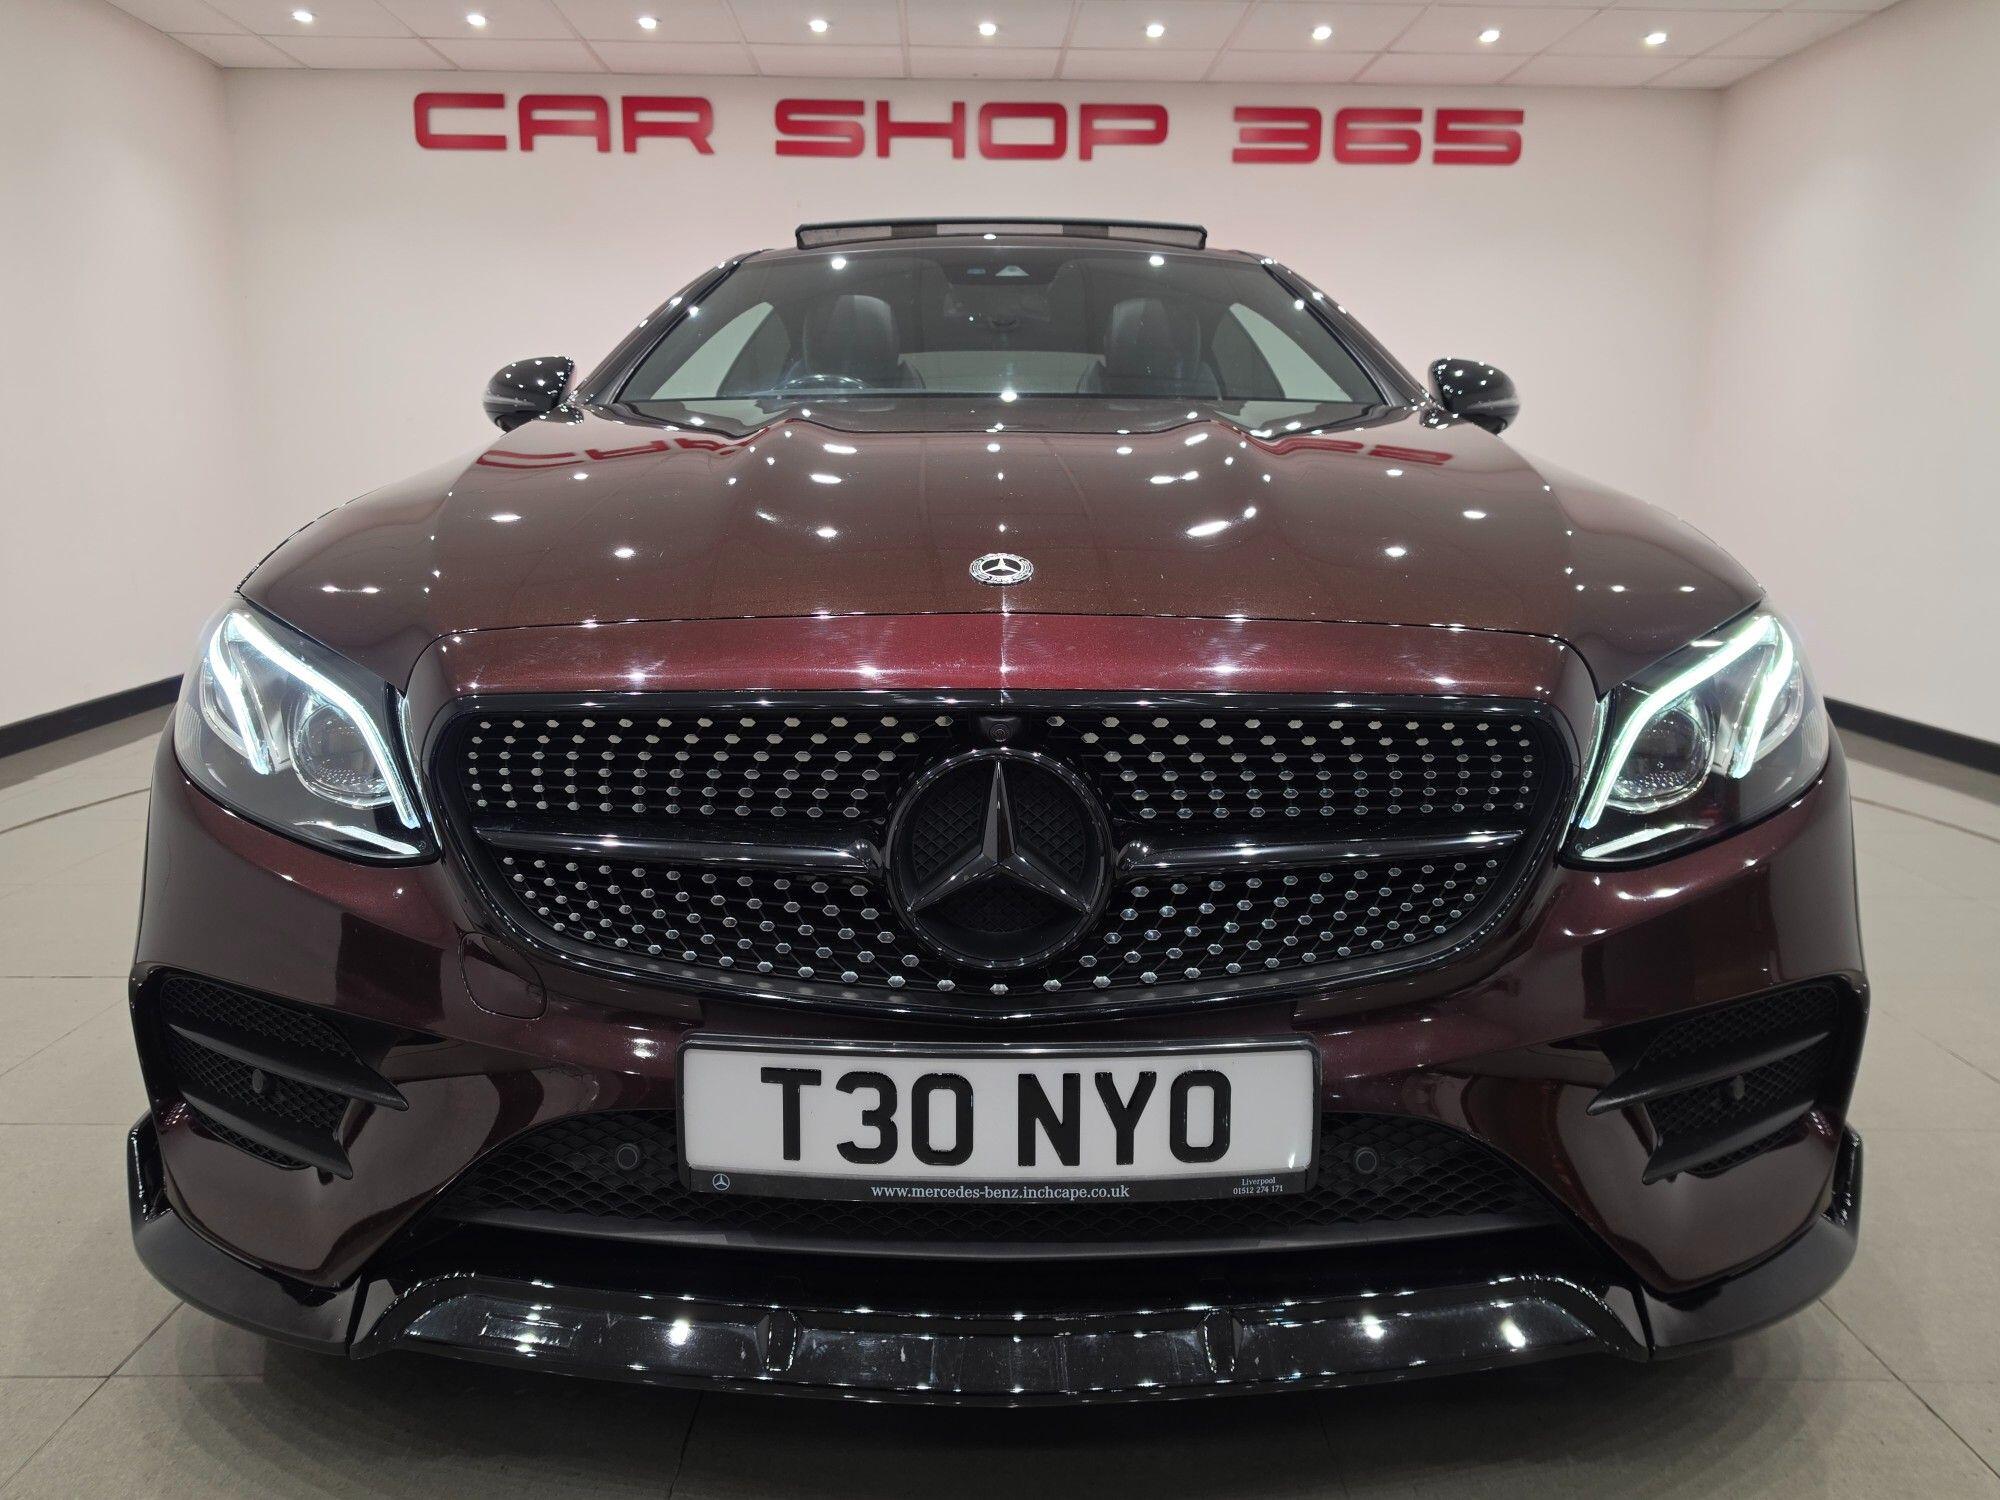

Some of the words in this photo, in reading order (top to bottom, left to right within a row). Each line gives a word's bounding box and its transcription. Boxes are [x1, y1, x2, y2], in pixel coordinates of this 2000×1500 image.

[413, 92, 715, 155] CAR
[775, 99, 1168, 160] SHOP
[1231, 106, 1525, 165] 365
[761, 1067, 975, 1166] T30
[1017, 1070, 1232, 1166] NYO
[1233, 1187, 1254, 1195] 01512
[1271, 1184, 1283, 1192] 171
[1241, 1176, 1276, 1186] Liverpool
[871, 1184, 1130, 1201] www.mercedes-benz.inchcape.co.uk
